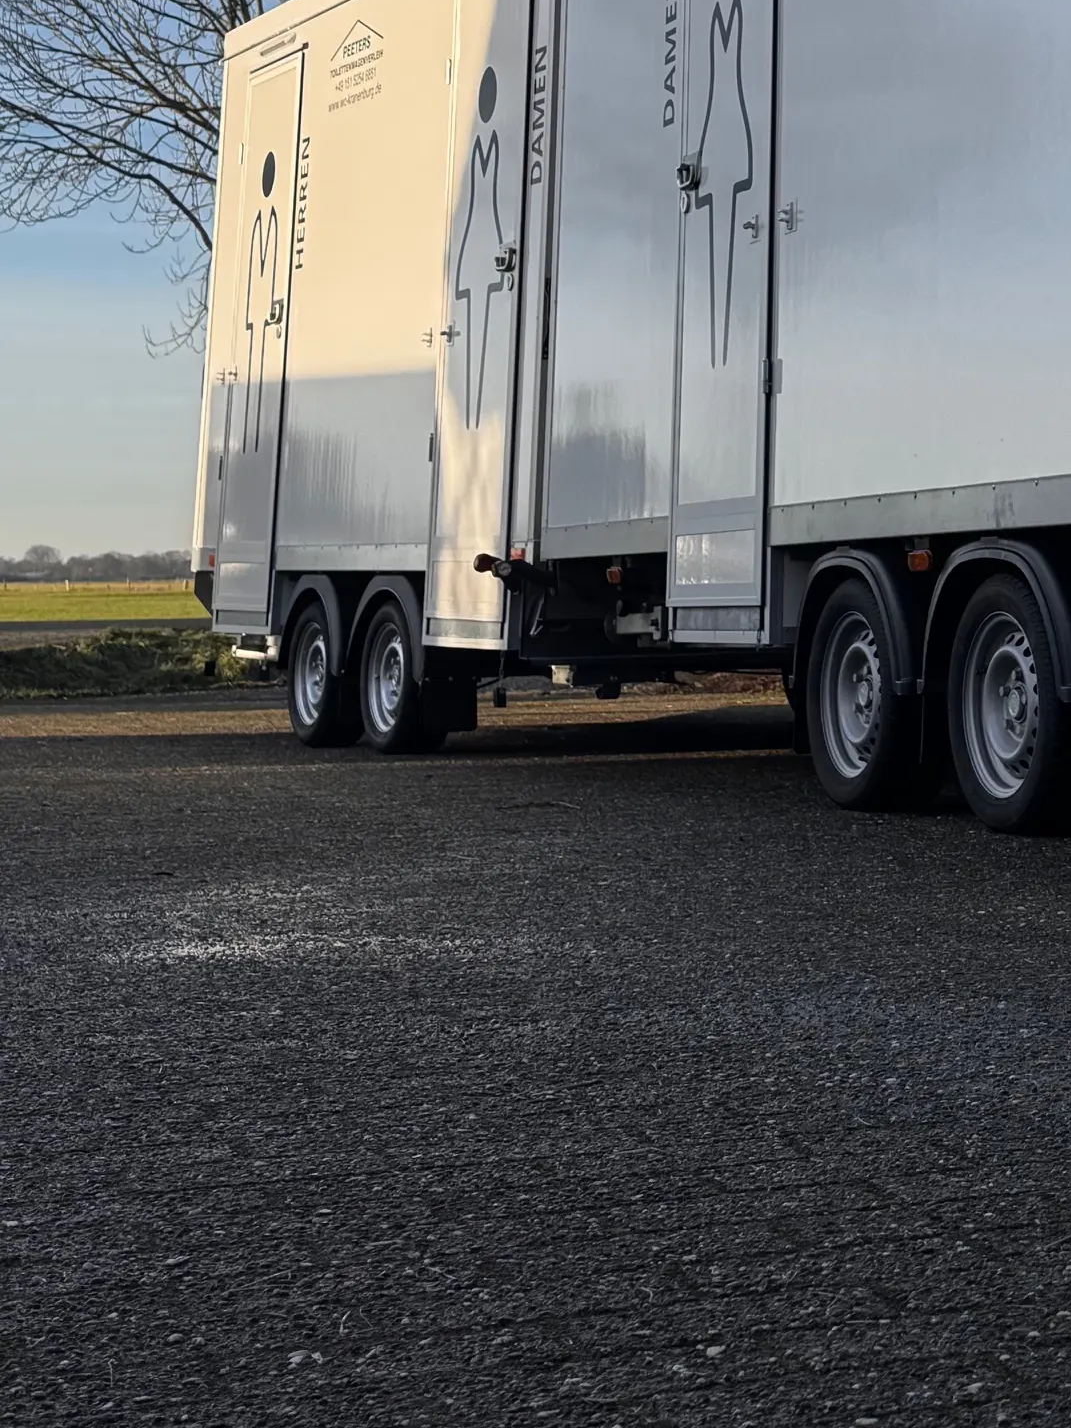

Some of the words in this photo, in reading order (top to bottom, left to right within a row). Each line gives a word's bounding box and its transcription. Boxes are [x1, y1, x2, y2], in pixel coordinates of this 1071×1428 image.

[342, 35, 371, 59] PEETERS
[530, 44, 548, 186] DAMEN
[295, 136, 310, 270] HERREN
